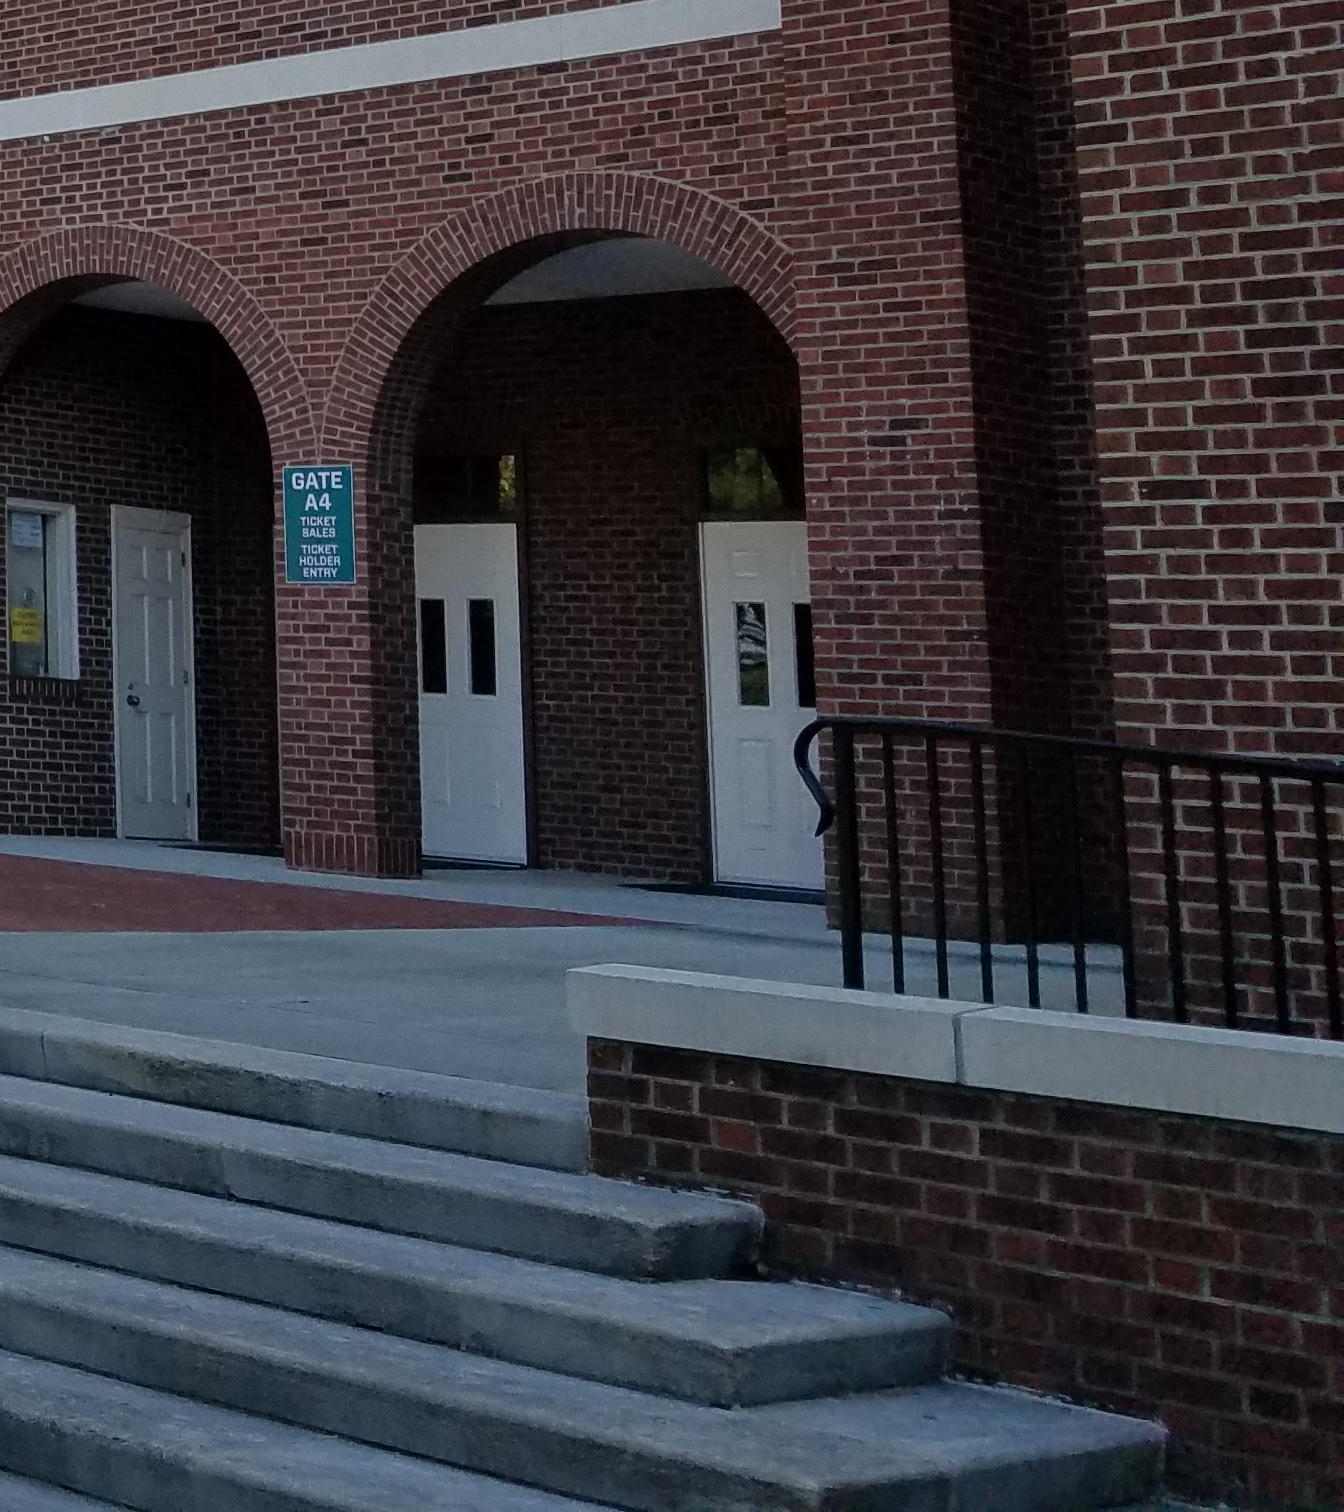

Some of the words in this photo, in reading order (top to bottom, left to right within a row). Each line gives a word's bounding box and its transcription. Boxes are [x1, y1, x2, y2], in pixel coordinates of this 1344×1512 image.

[291, 471, 343, 491] GATE
[304, 493, 332, 512] A4
[299, 516, 337, 527] TICKET
[302, 527, 336, 538] SALES
[300, 544, 338, 555] TICKET
[299, 556, 341, 567] HOLDER
[302, 567, 338, 578] ENTRY
